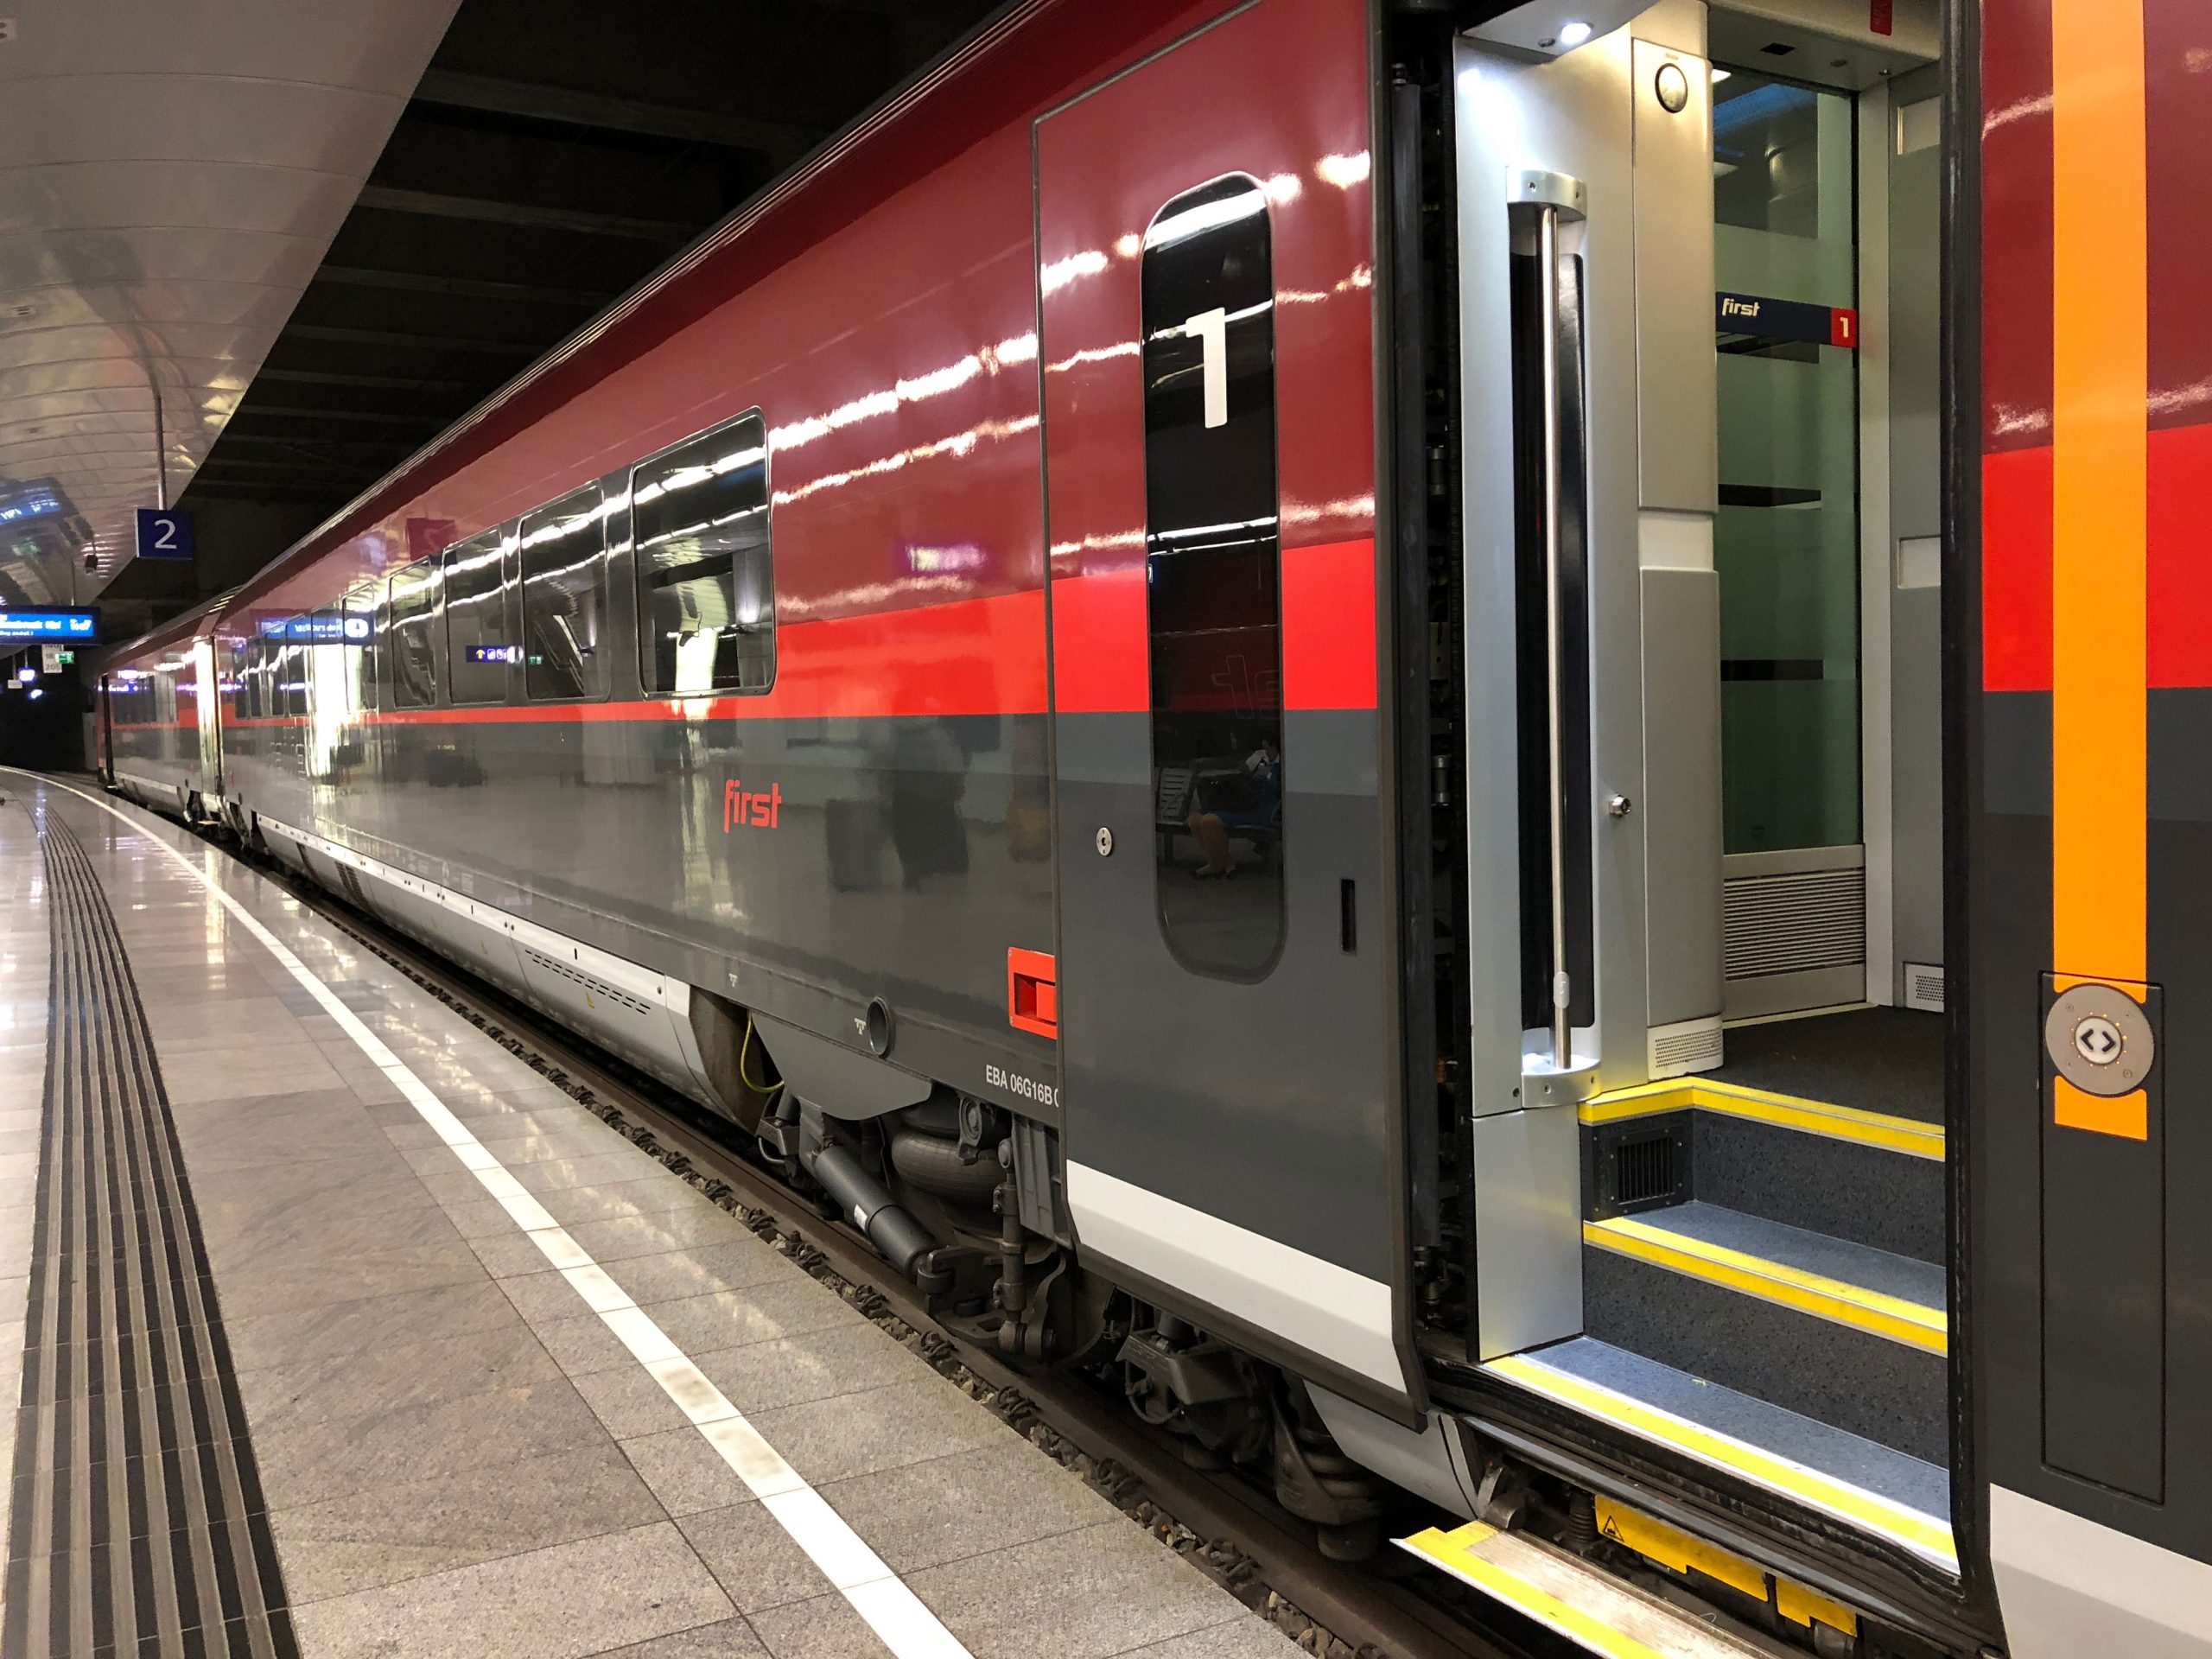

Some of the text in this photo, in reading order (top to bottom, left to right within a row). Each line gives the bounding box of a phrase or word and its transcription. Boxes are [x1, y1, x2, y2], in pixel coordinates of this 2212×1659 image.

[1721, 297, 1760, 317] first
[1840, 316, 1848, 338] 1
[1185, 307, 1227, 429] 1
[155, 519, 177, 549] 2
[724, 779, 782, 834] first
[986, 1064, 1008, 1090] EBA
[1010, 1073, 1052, 1105] 06G16B
